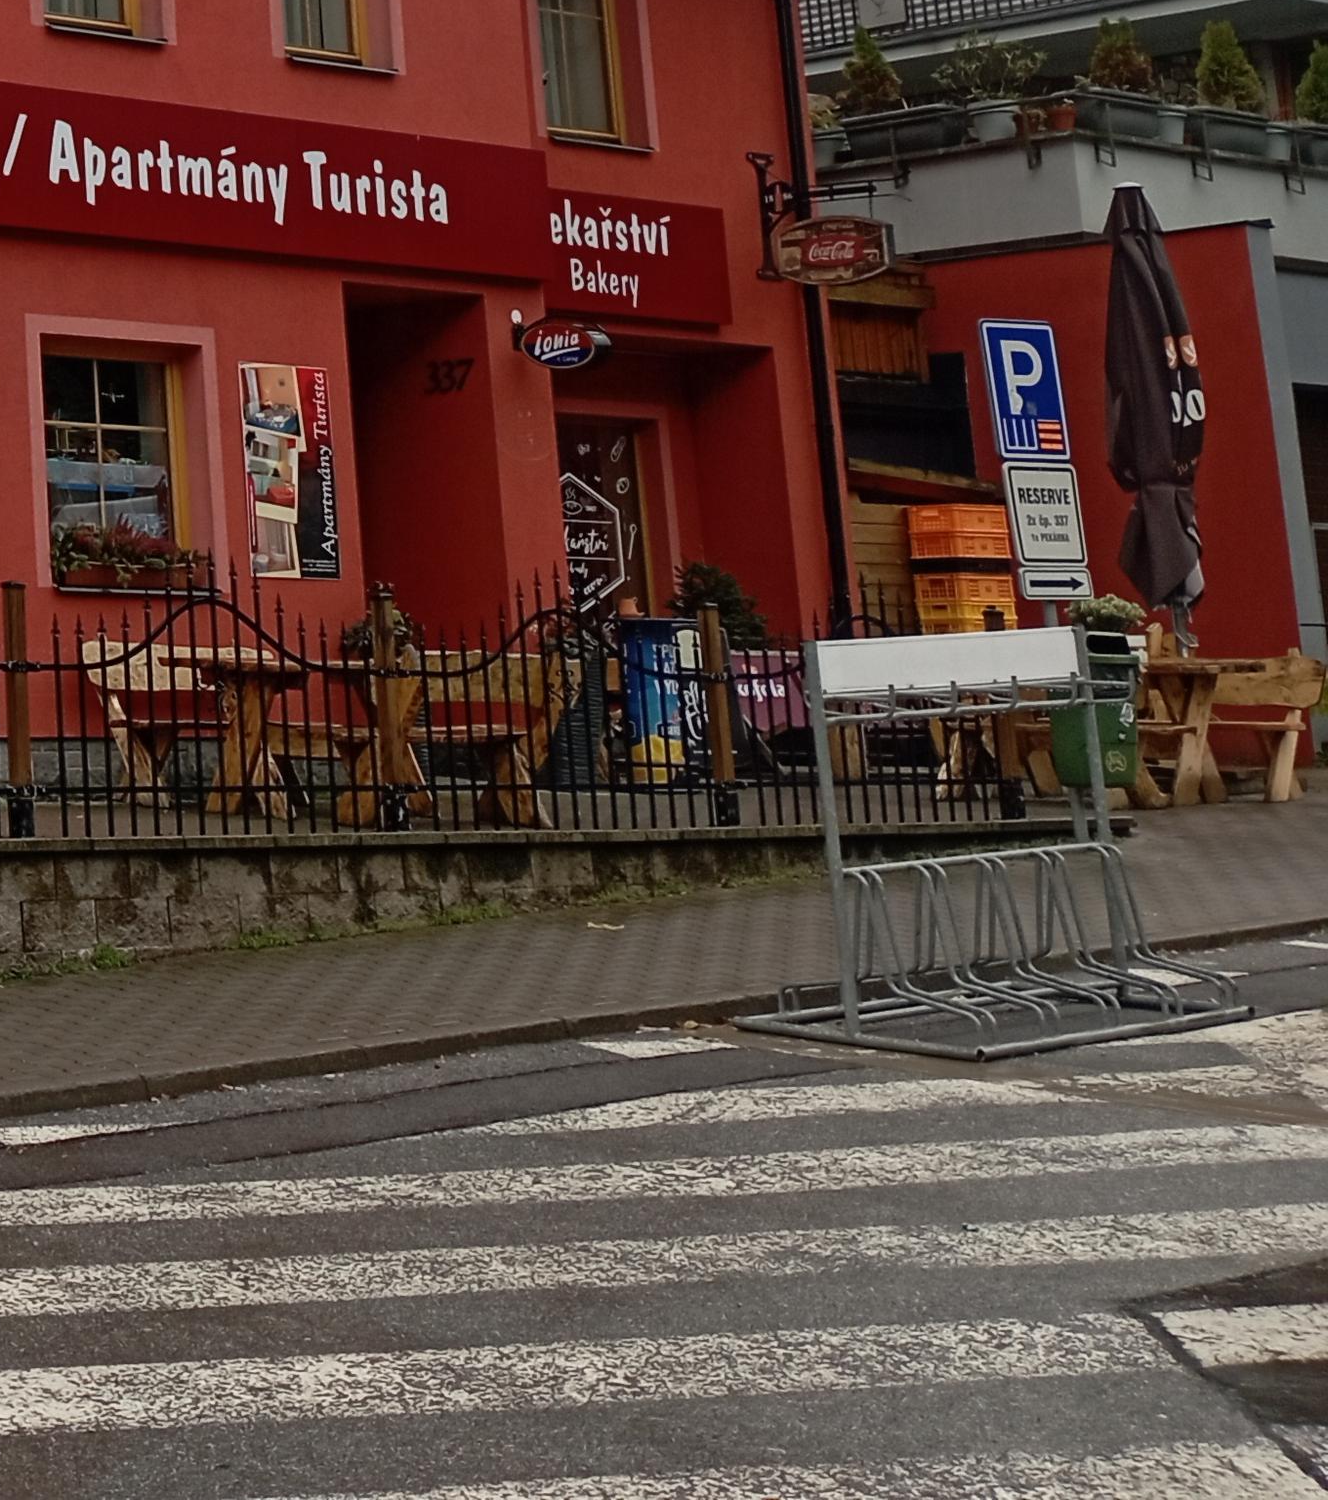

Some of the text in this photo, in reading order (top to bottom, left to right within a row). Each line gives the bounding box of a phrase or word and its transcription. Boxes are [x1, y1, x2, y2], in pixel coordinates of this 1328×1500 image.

[2, 113, 28, 177] /
[49, 118, 289, 227] Apartmány
[302, 150, 450, 226] Turista
[549, 198, 671, 257] ekařství
[570, 257, 640, 309] Bakery
[534, 329, 580, 357] ionia
[312, 371, 339, 557] Apartmány Turista
[1018, 487, 1072, 505] RESERVE
[1054, 514, 1069, 526] 337
